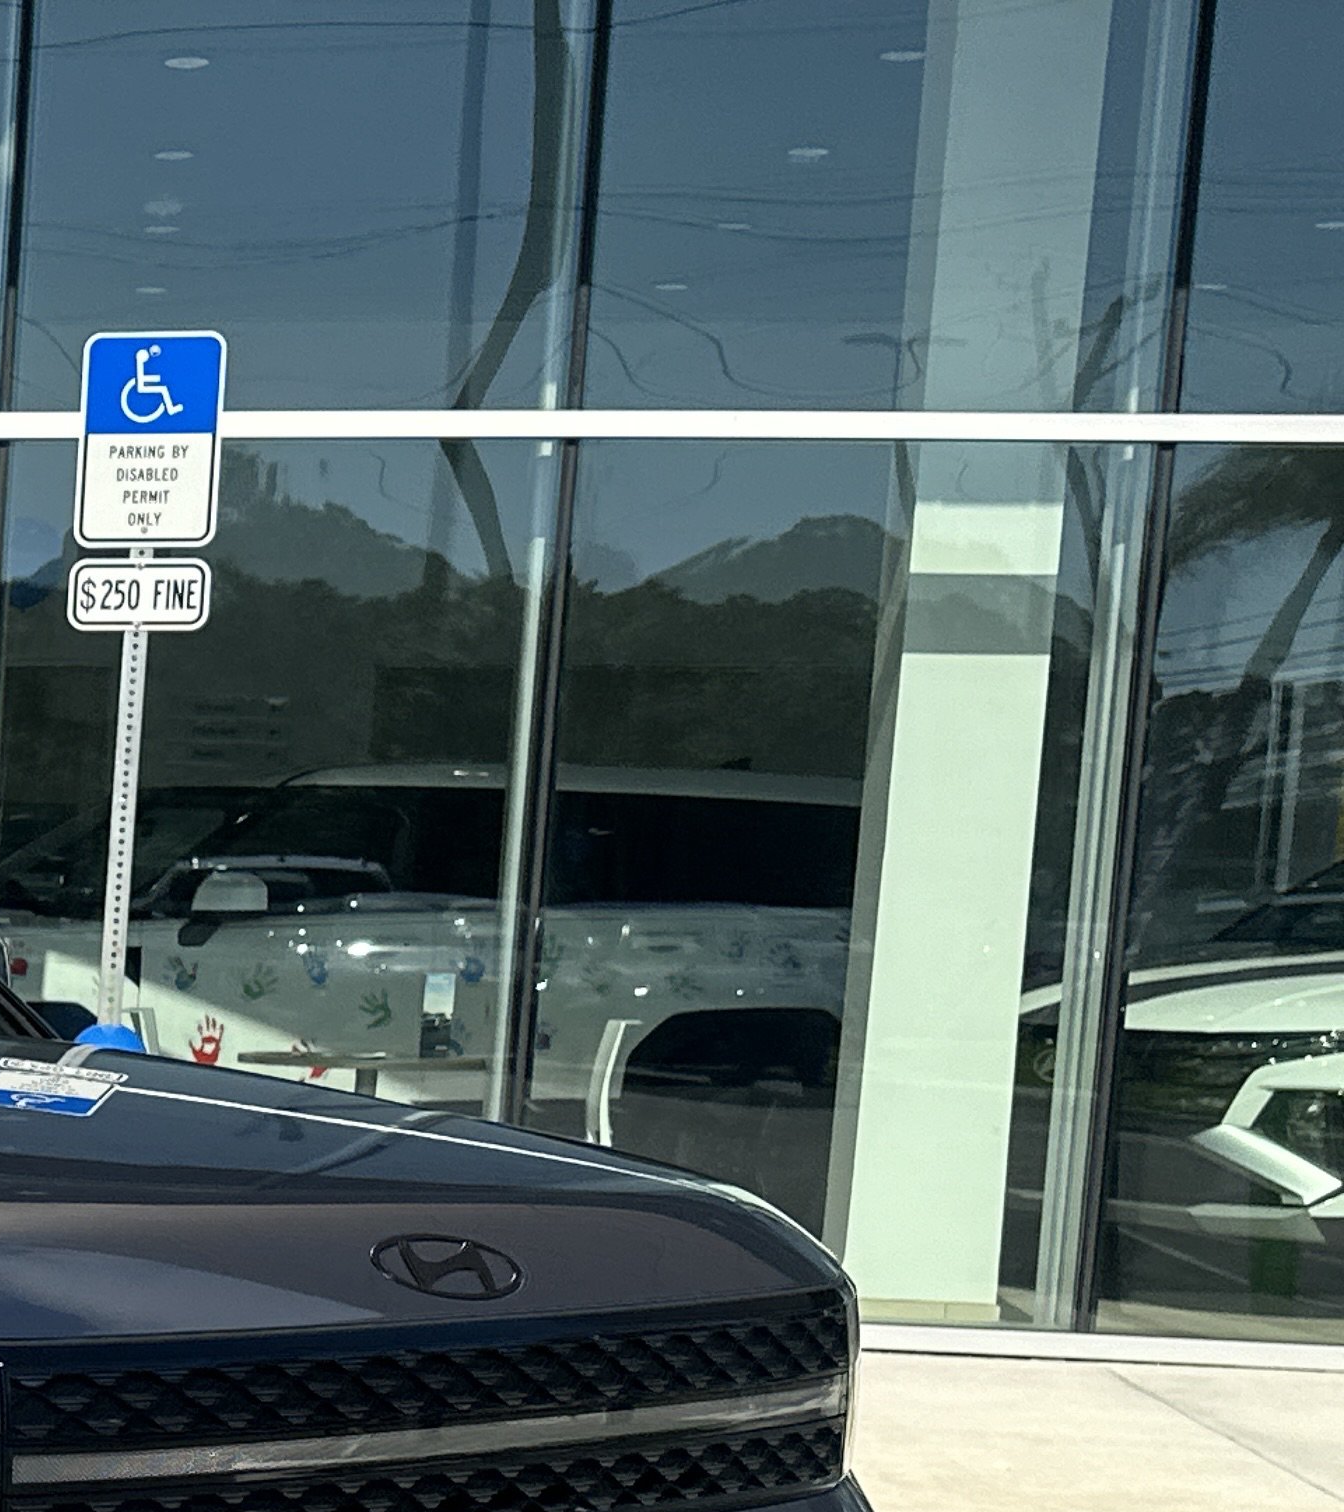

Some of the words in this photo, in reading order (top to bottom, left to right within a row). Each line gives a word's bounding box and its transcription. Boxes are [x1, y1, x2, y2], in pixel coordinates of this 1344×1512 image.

[109, 445, 165, 460] PARKING
[172, 445, 189, 459] BY
[116, 467, 179, 482] DISABLED
[122, 490, 170, 504] PERMIT
[128, 512, 162, 527] ONLY
[80, 577, 141, 614] $250
[153, 578, 198, 611] FINE
